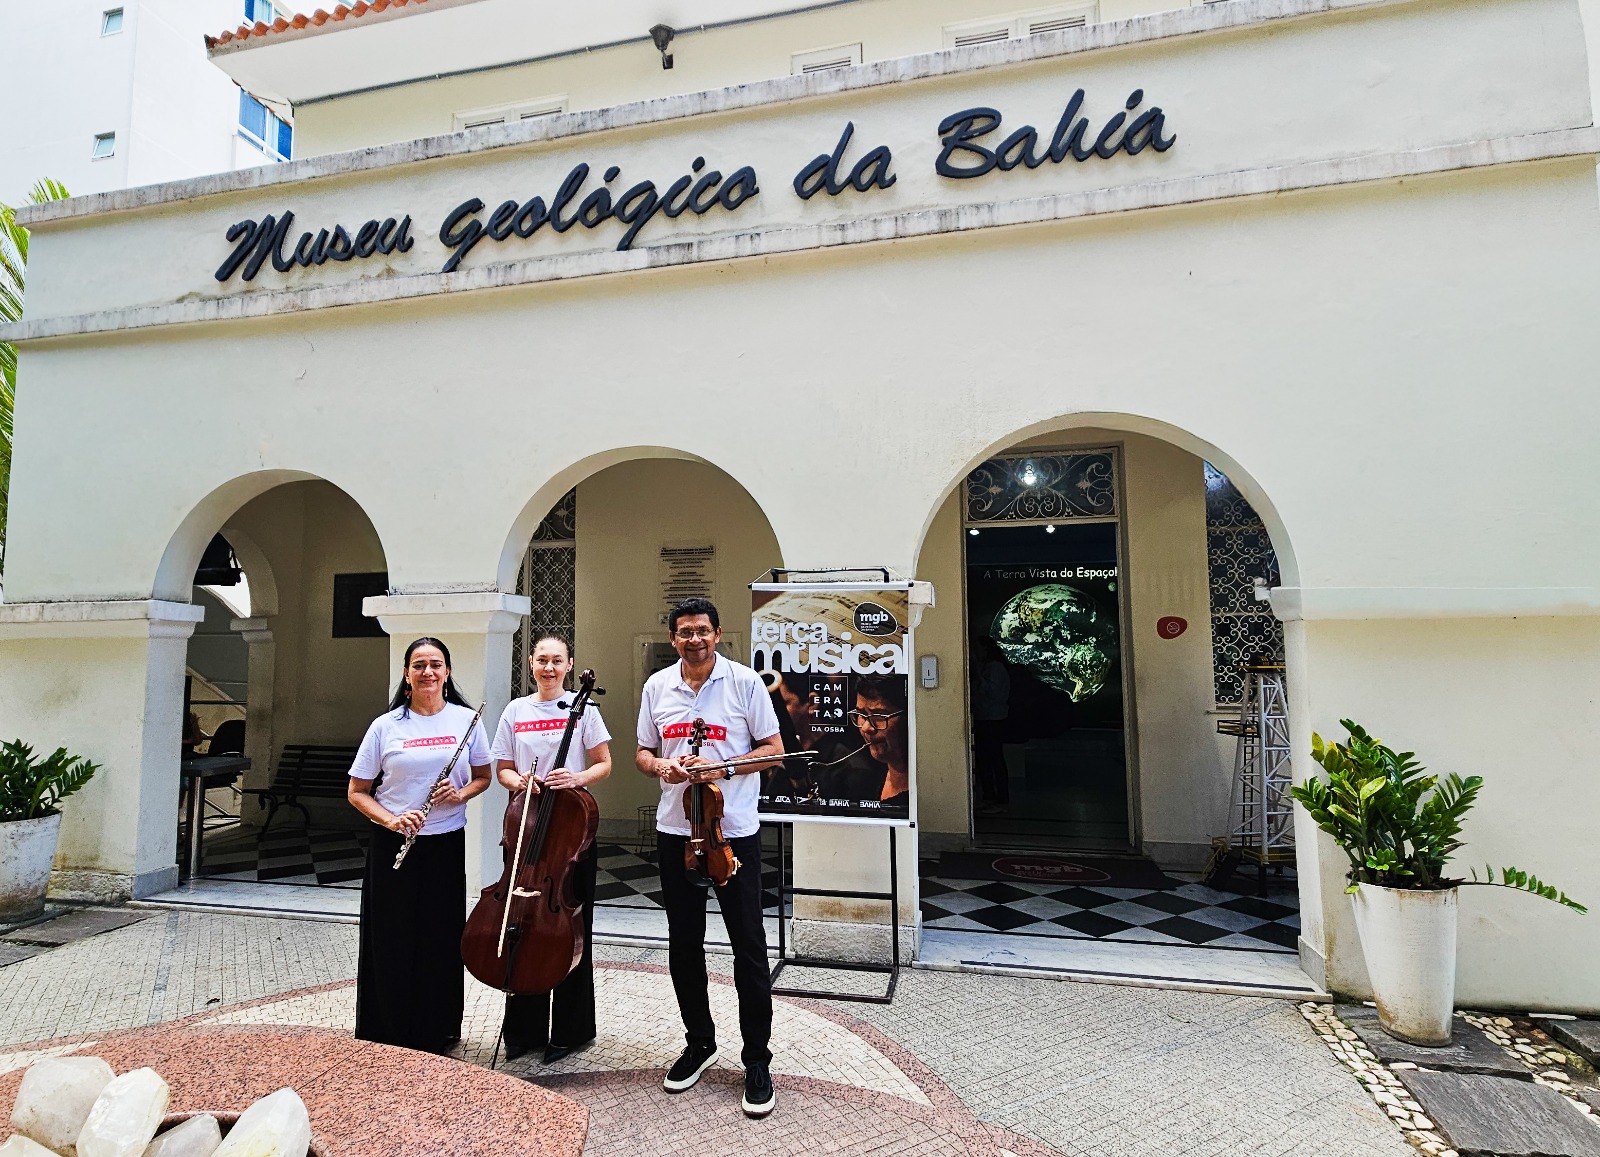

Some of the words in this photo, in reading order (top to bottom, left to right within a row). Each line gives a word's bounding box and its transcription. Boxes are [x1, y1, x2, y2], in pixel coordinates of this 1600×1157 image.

[215, 209, 414, 282] Museu
[793, 121, 897, 200] da
[935, 88, 1177, 179] Bahia
[984, 570, 991, 579] A
[995, 569, 1026, 579] Terra
[1029, 568, 1057, 578] Vista
[1059, 567, 1073, 578] do
[859, 611, 889, 624] mgb
[751, 617, 828, 651] terça
[813, 683, 842, 691] CAM
[813, 696, 842, 705] ERA
[403, 738, 451, 747] CAMERATA
